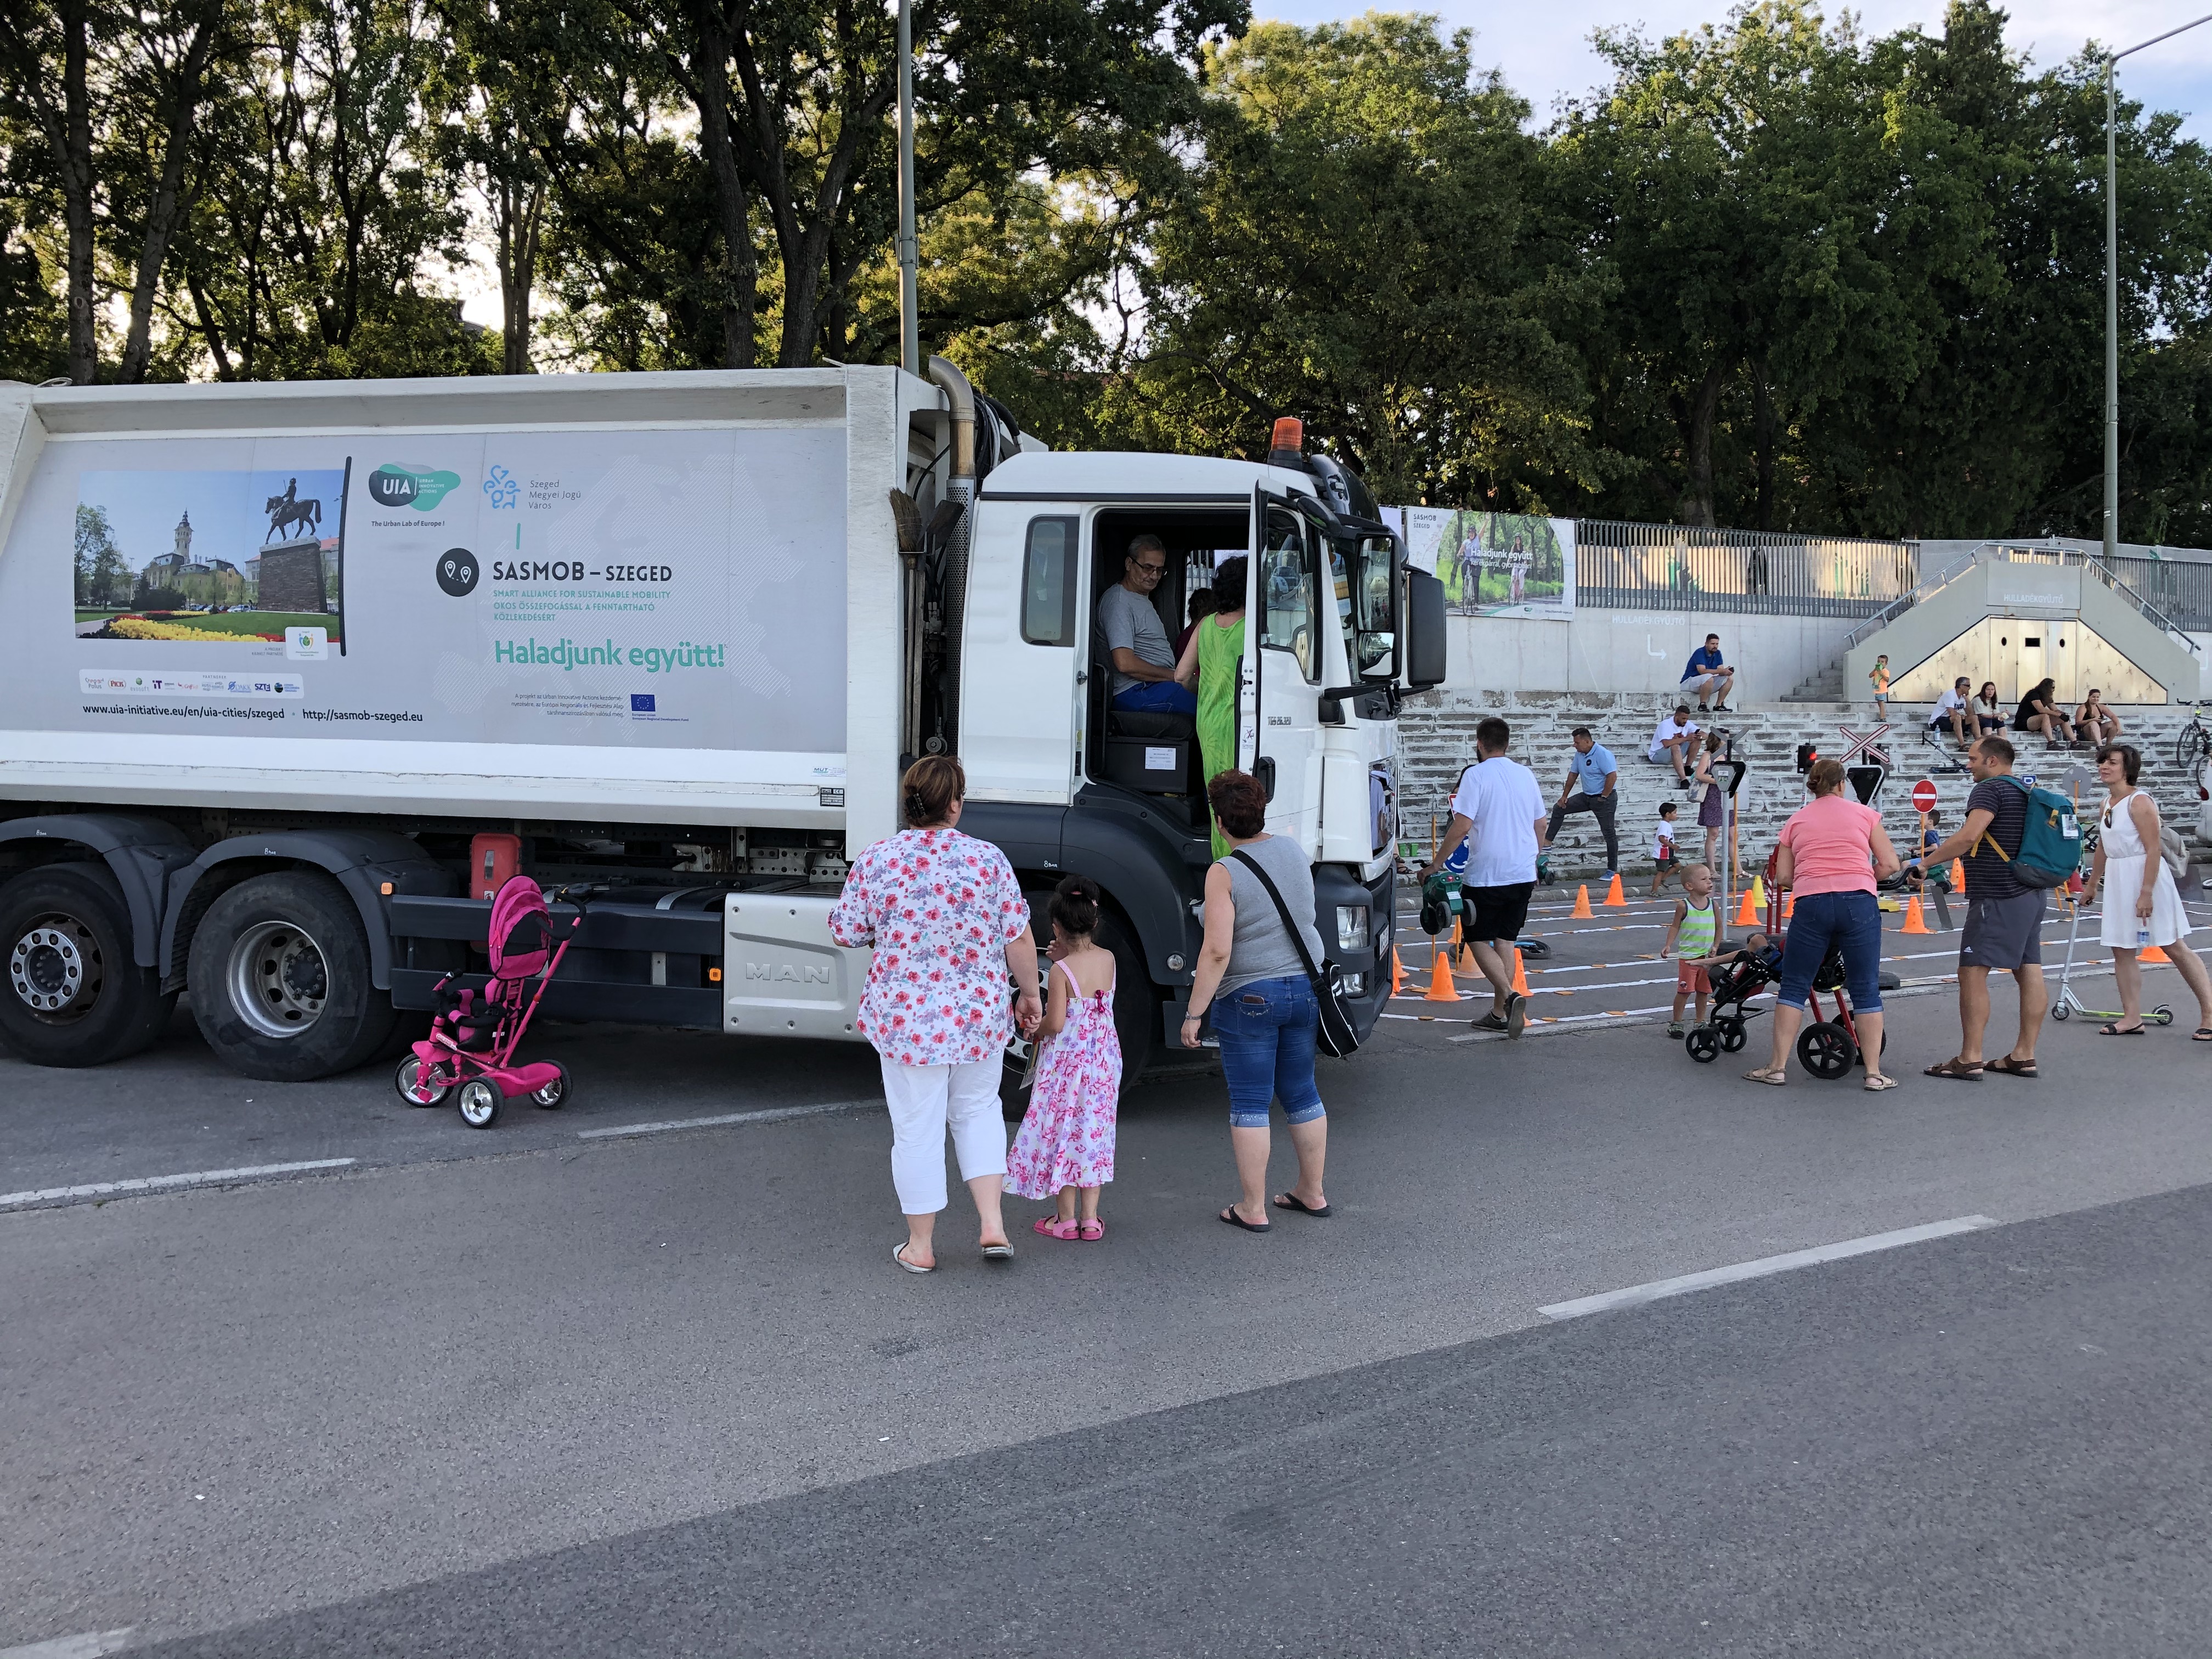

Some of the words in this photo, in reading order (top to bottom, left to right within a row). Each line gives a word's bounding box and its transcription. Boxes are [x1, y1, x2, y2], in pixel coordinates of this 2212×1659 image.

[382, 478, 411, 494] UIA
[529, 479, 560, 489] Szeged
[529, 490, 559, 500] Megyei
[562, 490, 581, 500] Jogú
[1470, 548, 1508, 560] Haladjunk
[493, 561, 584, 581] SASMOB
[606, 566, 672, 582] SZEGED
[518, 600, 583, 611] ÖSSZEFOGÁSSAL
[592, 601, 654, 611] FENNTARTHATÓ
[494, 612, 556, 621] KÖZLEKEDÉSÉRT
[495, 637, 623, 671] Haladjunk
[629, 641, 724, 673] együtt!
[82, 704, 285, 720] www.uia-initiative.eu/en/uia-cities/szeged
[302, 708, 423, 723] http://sasmob-szeged.eu
[746, 962, 830, 984] MAN
